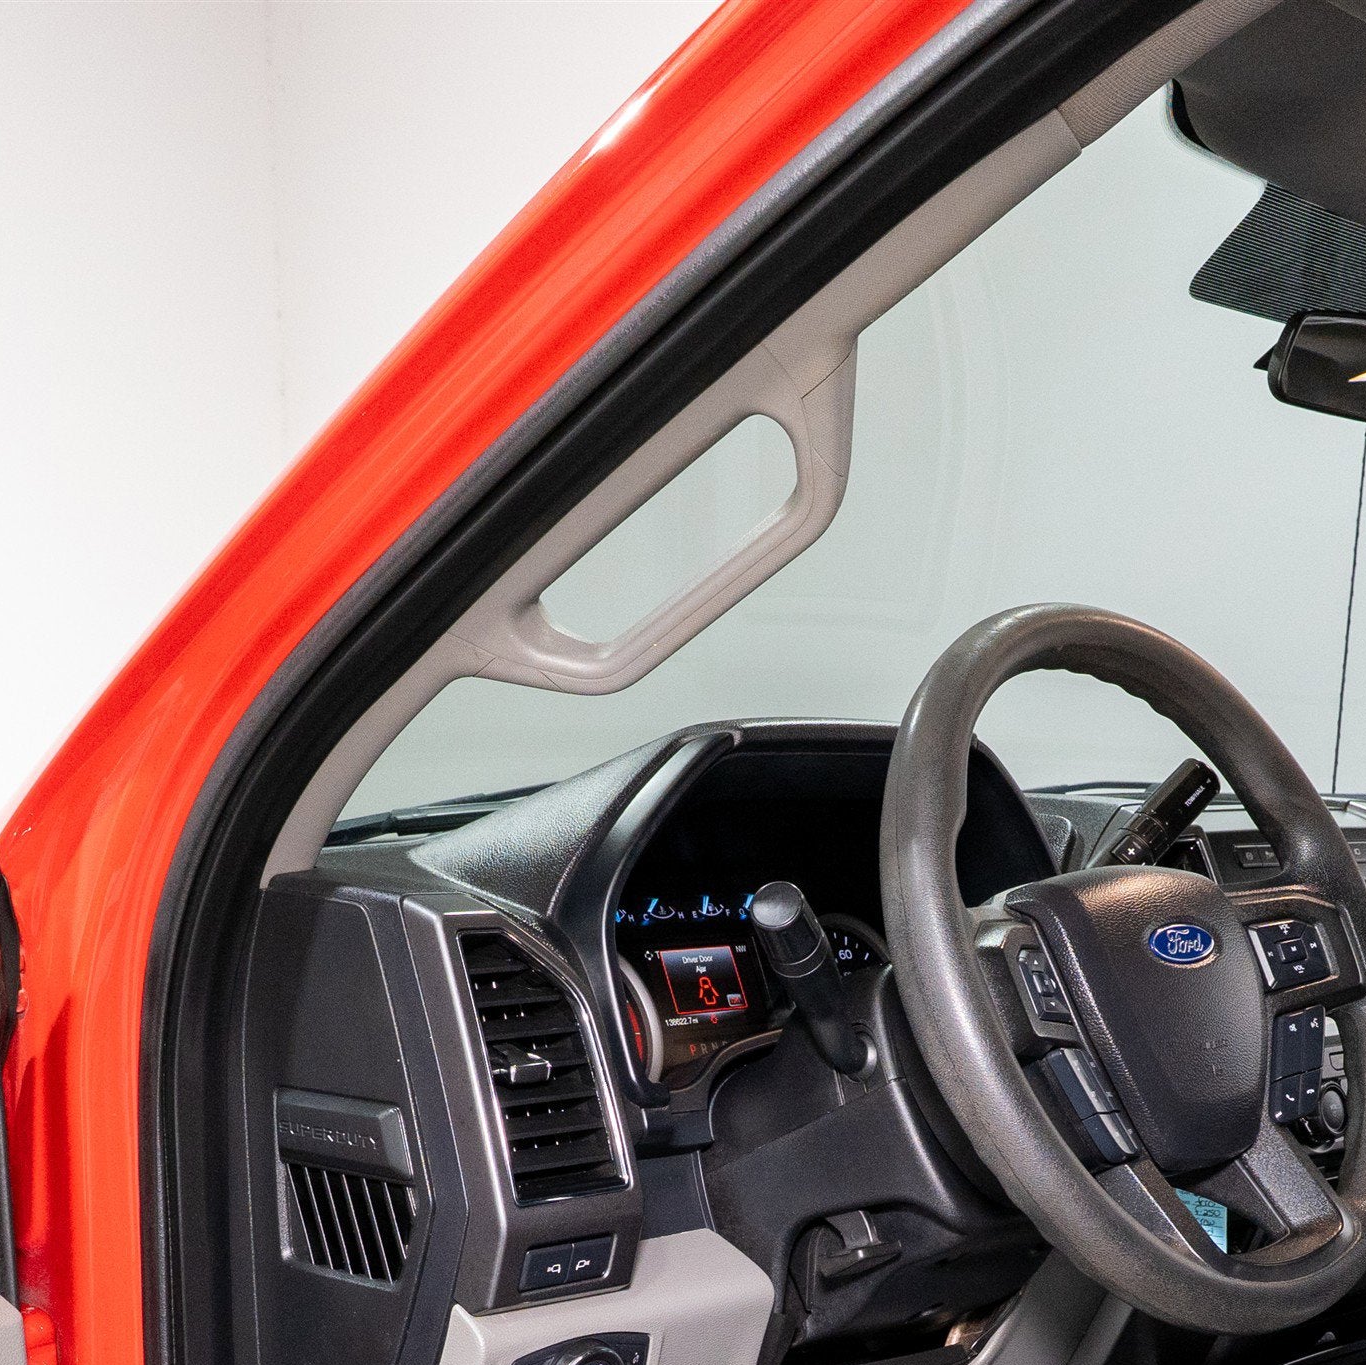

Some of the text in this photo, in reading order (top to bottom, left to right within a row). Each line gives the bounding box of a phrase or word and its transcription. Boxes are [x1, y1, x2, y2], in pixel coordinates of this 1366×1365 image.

[1167, 929, 1204, 954] Ford
[682, 955, 714, 964] Driver Door
[838, 949, 853, 960] 60
[689, 1044, 696, 1056] P
[700, 1043, 708, 1055] R
[335, 1130, 377, 1150] DUTY
